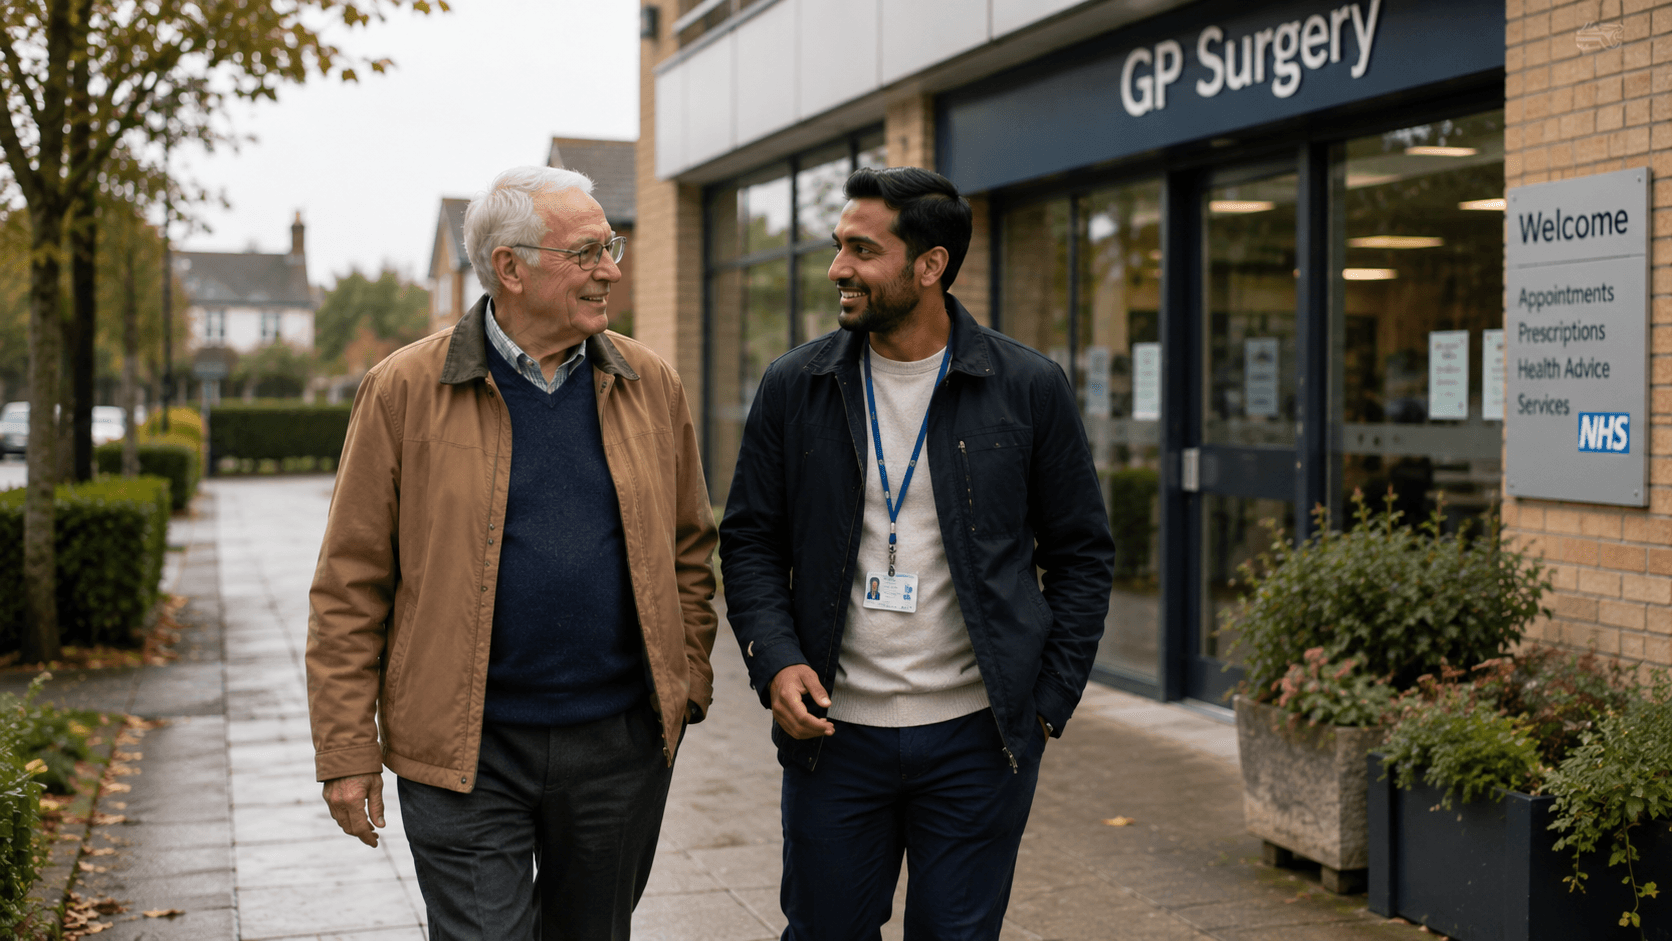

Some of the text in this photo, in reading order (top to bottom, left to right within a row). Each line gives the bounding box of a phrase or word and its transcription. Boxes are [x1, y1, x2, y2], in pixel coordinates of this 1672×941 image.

[1120, 0, 1381, 117] GP Surgery
[1519, 208, 1629, 245] Welcome
[1518, 283, 1615, 313] Appointments
[1518, 320, 1606, 347] Prescriptions
[1518, 357, 1611, 380] Health Advice
[1518, 393, 1570, 416] Services
[1579, 415, 1628, 451] NHS
